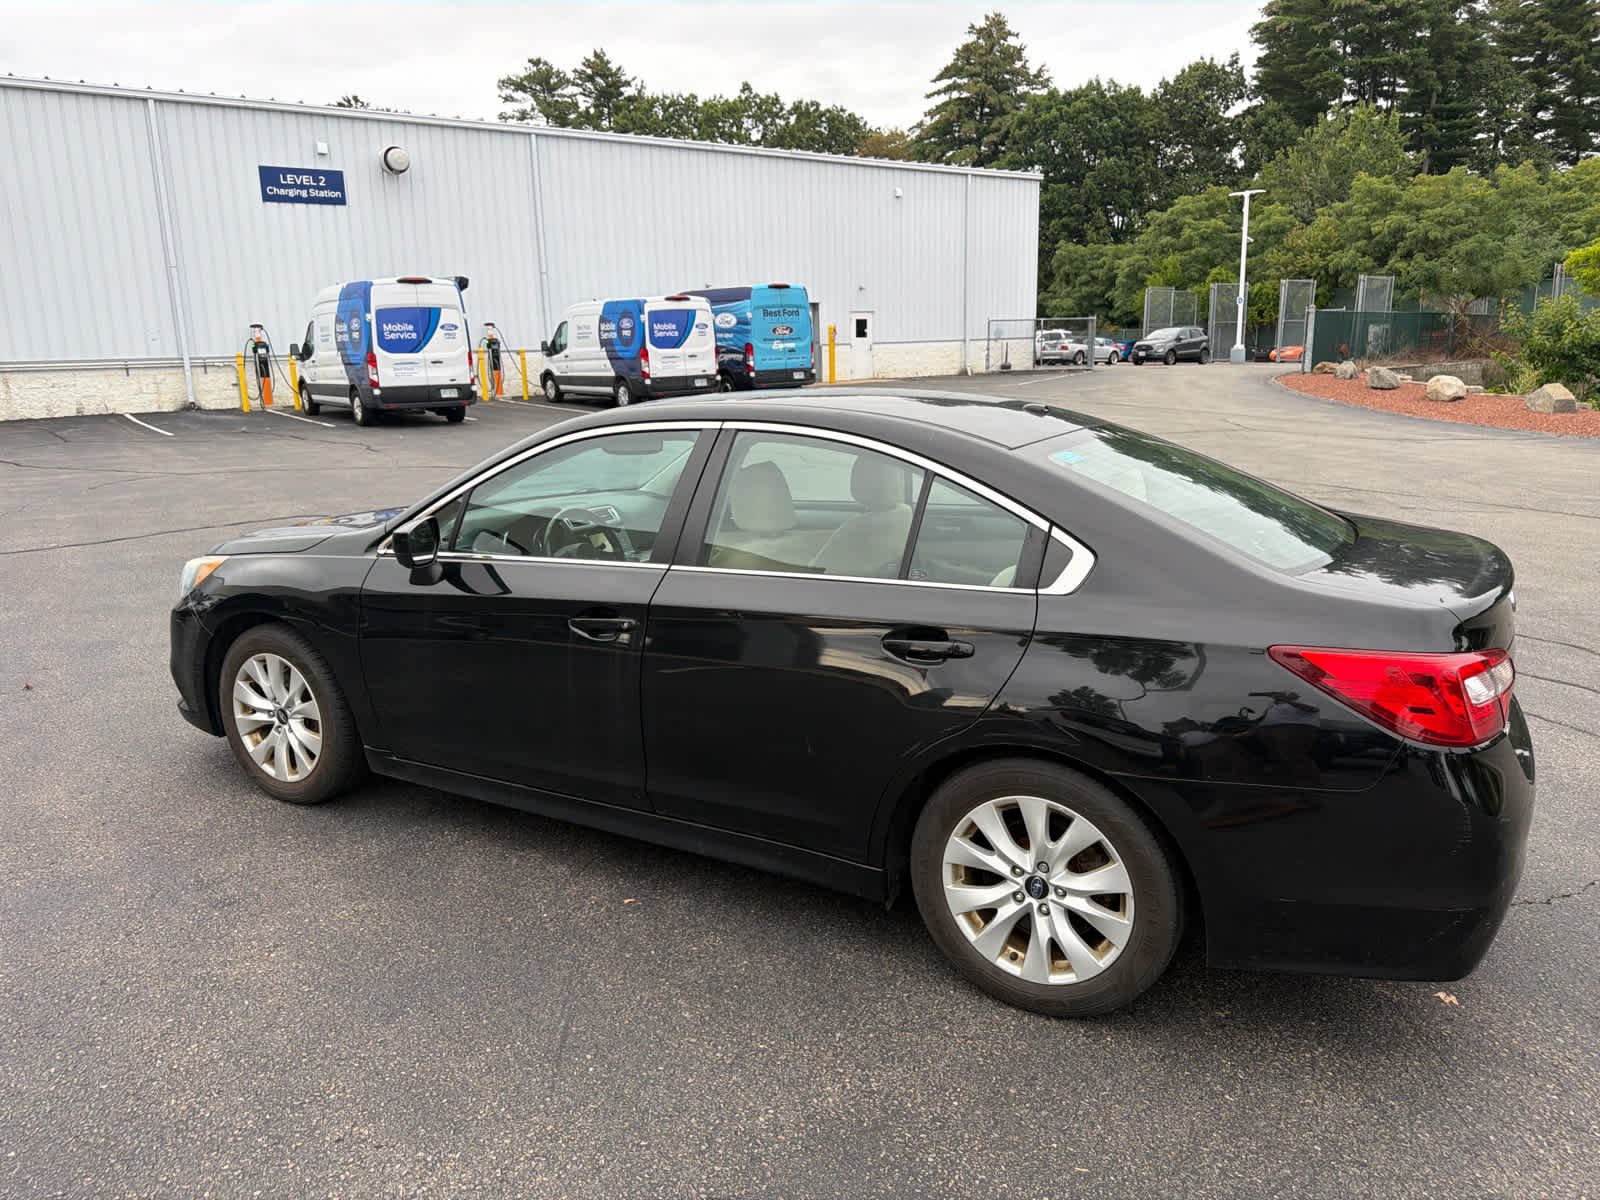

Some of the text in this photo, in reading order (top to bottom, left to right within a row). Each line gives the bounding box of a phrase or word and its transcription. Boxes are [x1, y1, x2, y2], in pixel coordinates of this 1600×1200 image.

[280, 173, 326, 186] LEVEL 2
[266, 186, 342, 198] Charging Station
[763, 308, 799, 317] Best Ford
[383, 323, 414, 332] Mobile
[653, 322, 677, 330] Mobile
[384, 332, 417, 340] Service
[654, 330, 679, 338] Service
